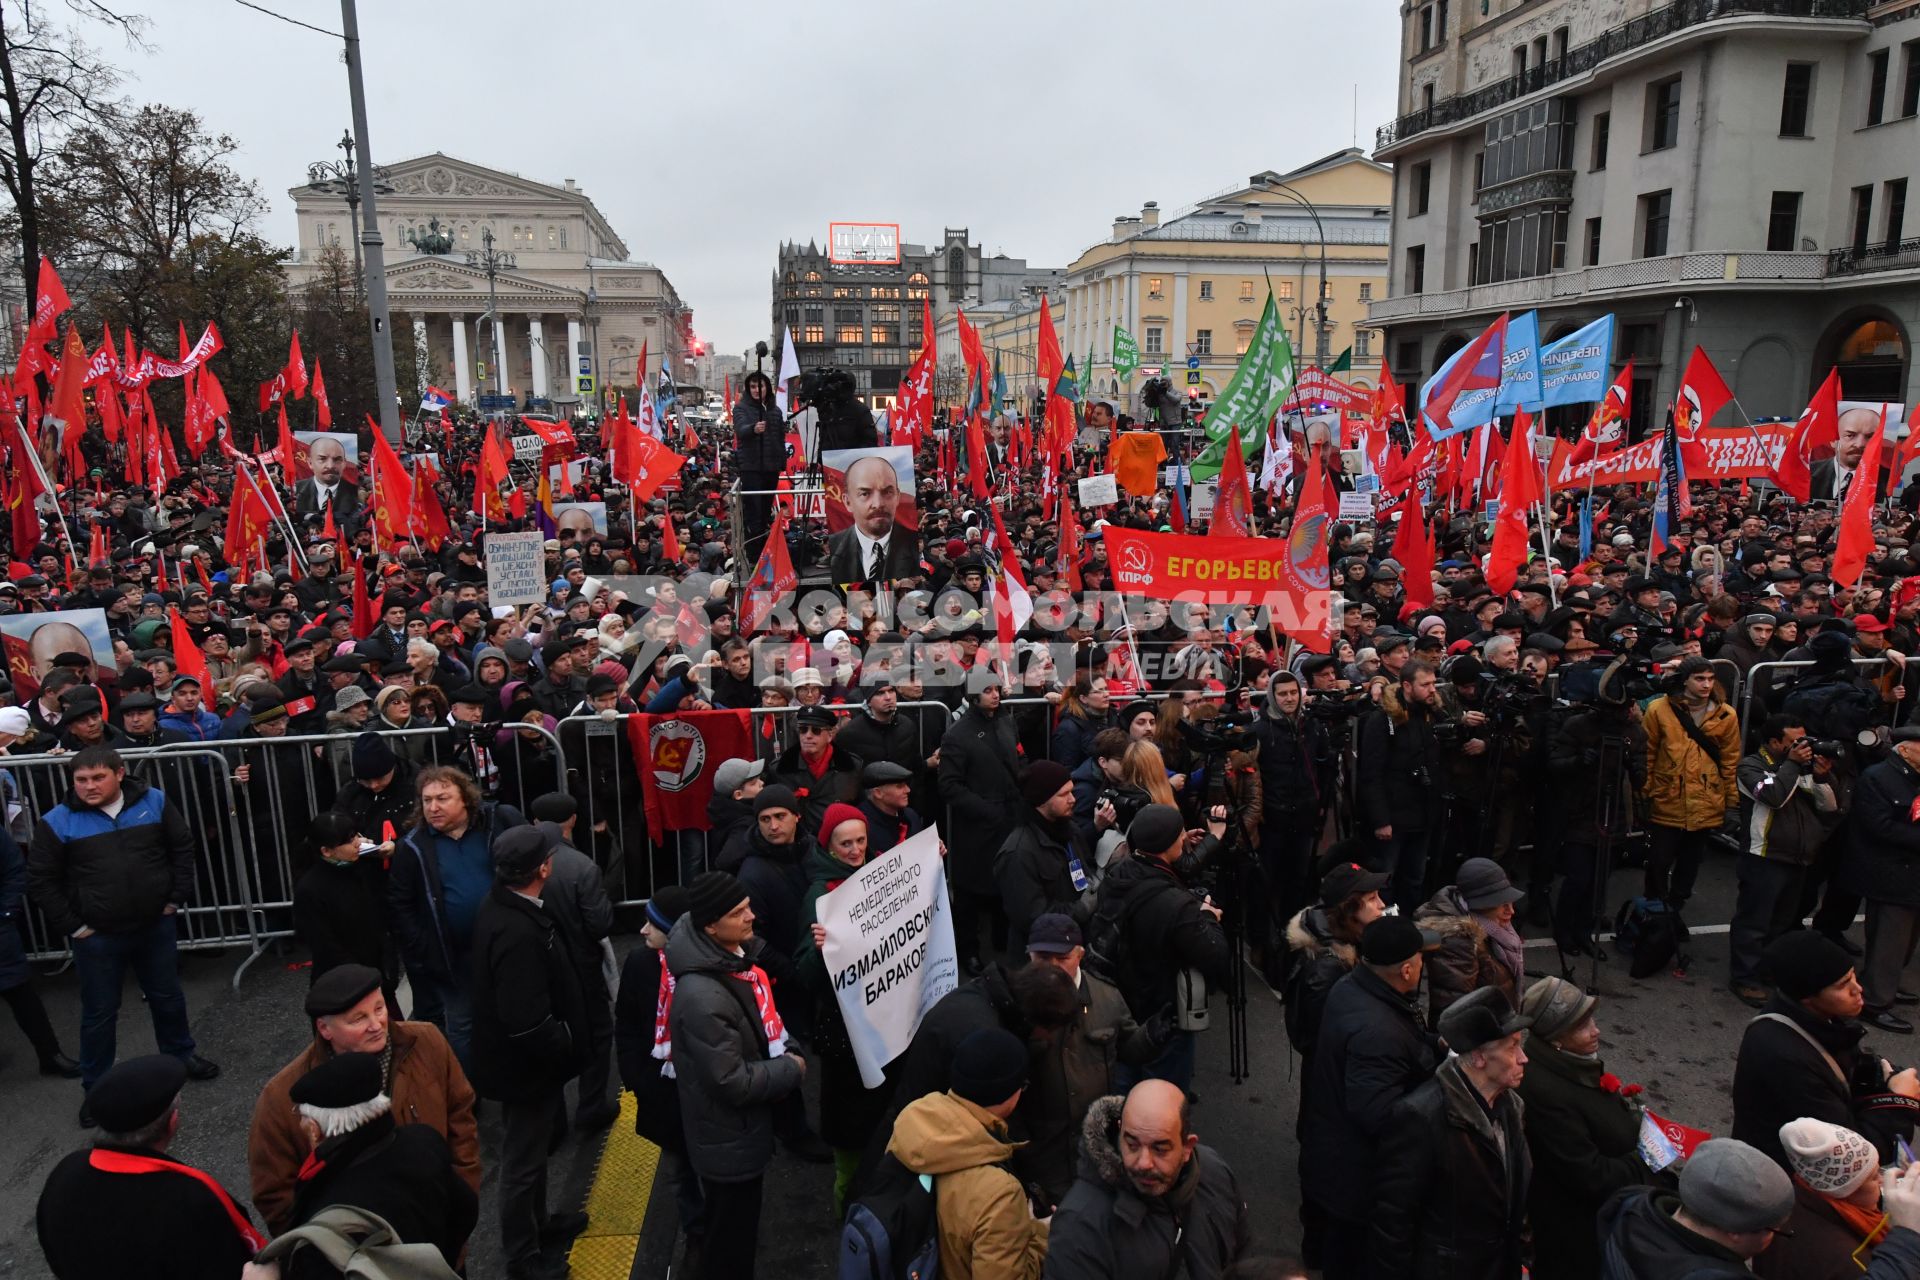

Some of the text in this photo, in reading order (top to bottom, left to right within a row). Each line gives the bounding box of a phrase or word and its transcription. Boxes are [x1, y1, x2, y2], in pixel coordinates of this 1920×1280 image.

[1118, 570, 1154, 586] КПРФ
[849, 862, 922, 924] НЕМЕДЛЕННОГО
[860, 854, 903, 893] ТРЕБУЕМ
[861, 884, 920, 938] РАССЕЛЕНИЯ
